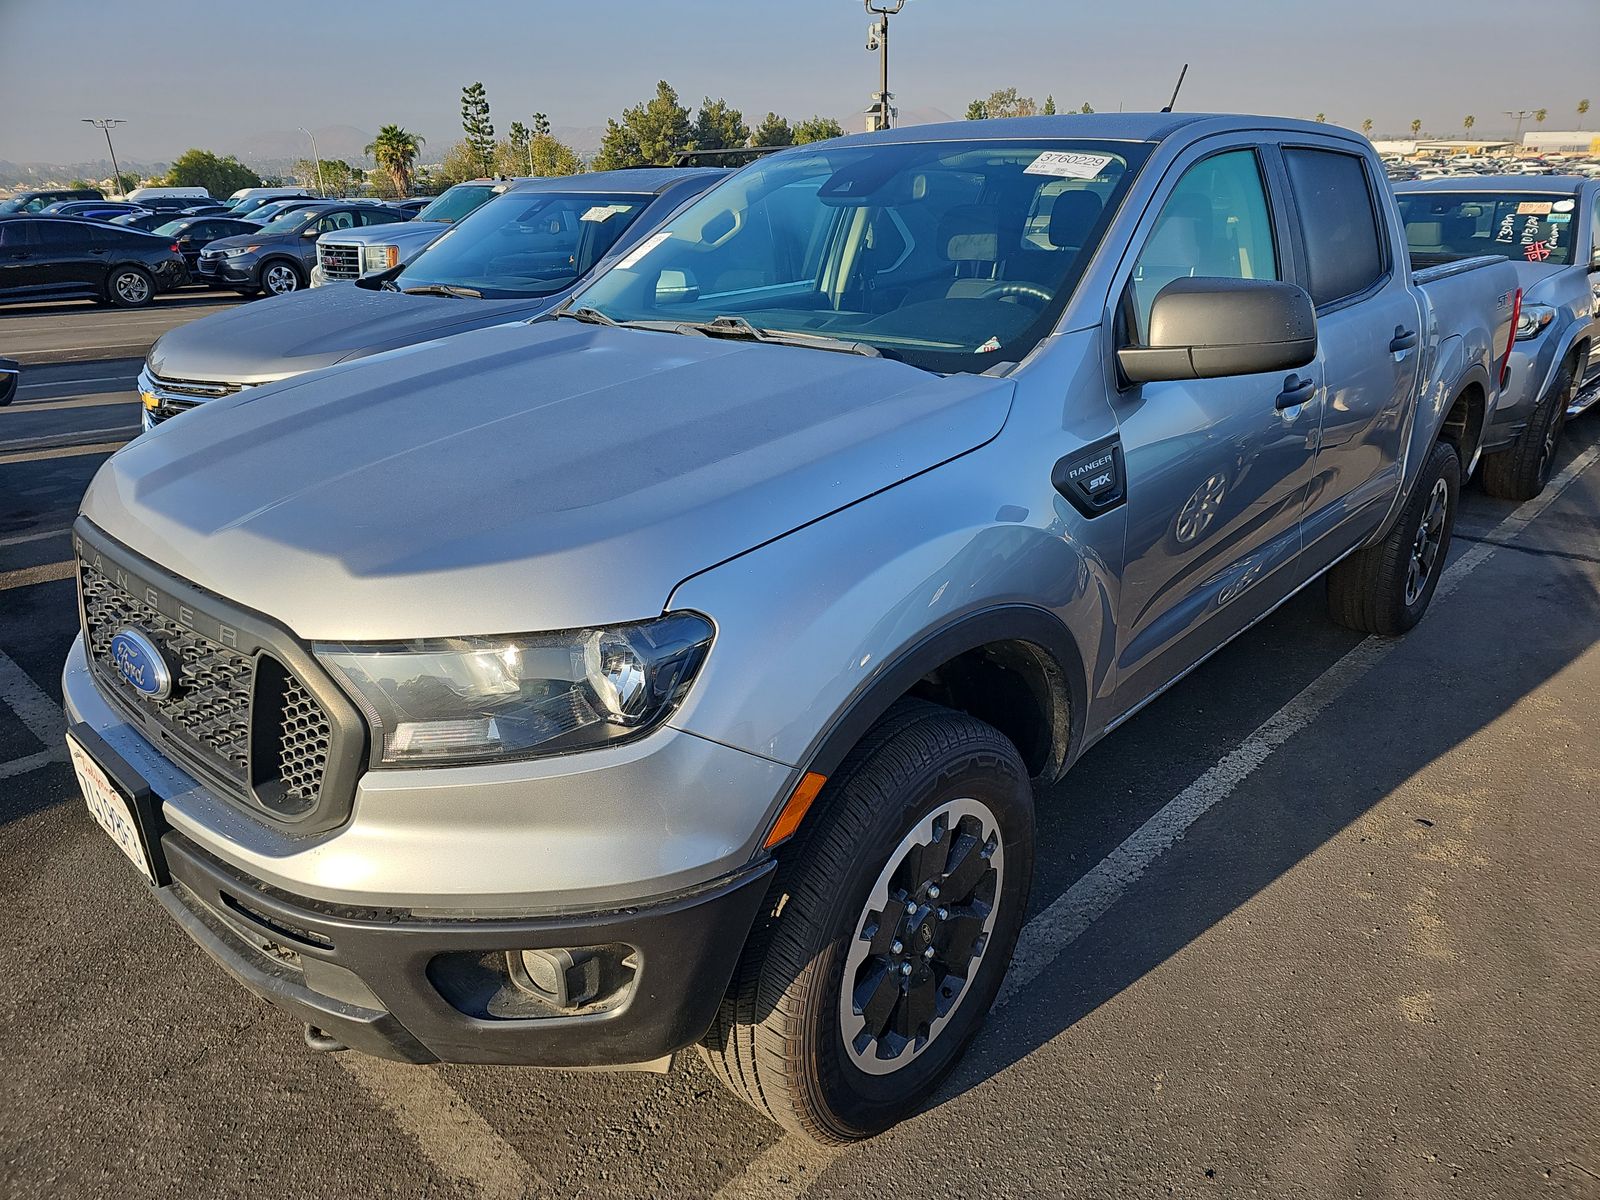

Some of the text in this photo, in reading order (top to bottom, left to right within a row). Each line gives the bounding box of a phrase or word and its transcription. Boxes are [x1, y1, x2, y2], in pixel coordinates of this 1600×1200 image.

[1041, 153, 1104, 166] 3760229
[1070, 455, 1112, 478] RANGER
[1090, 473, 1111, 489] STX
[74, 537, 238, 648] RANGER
